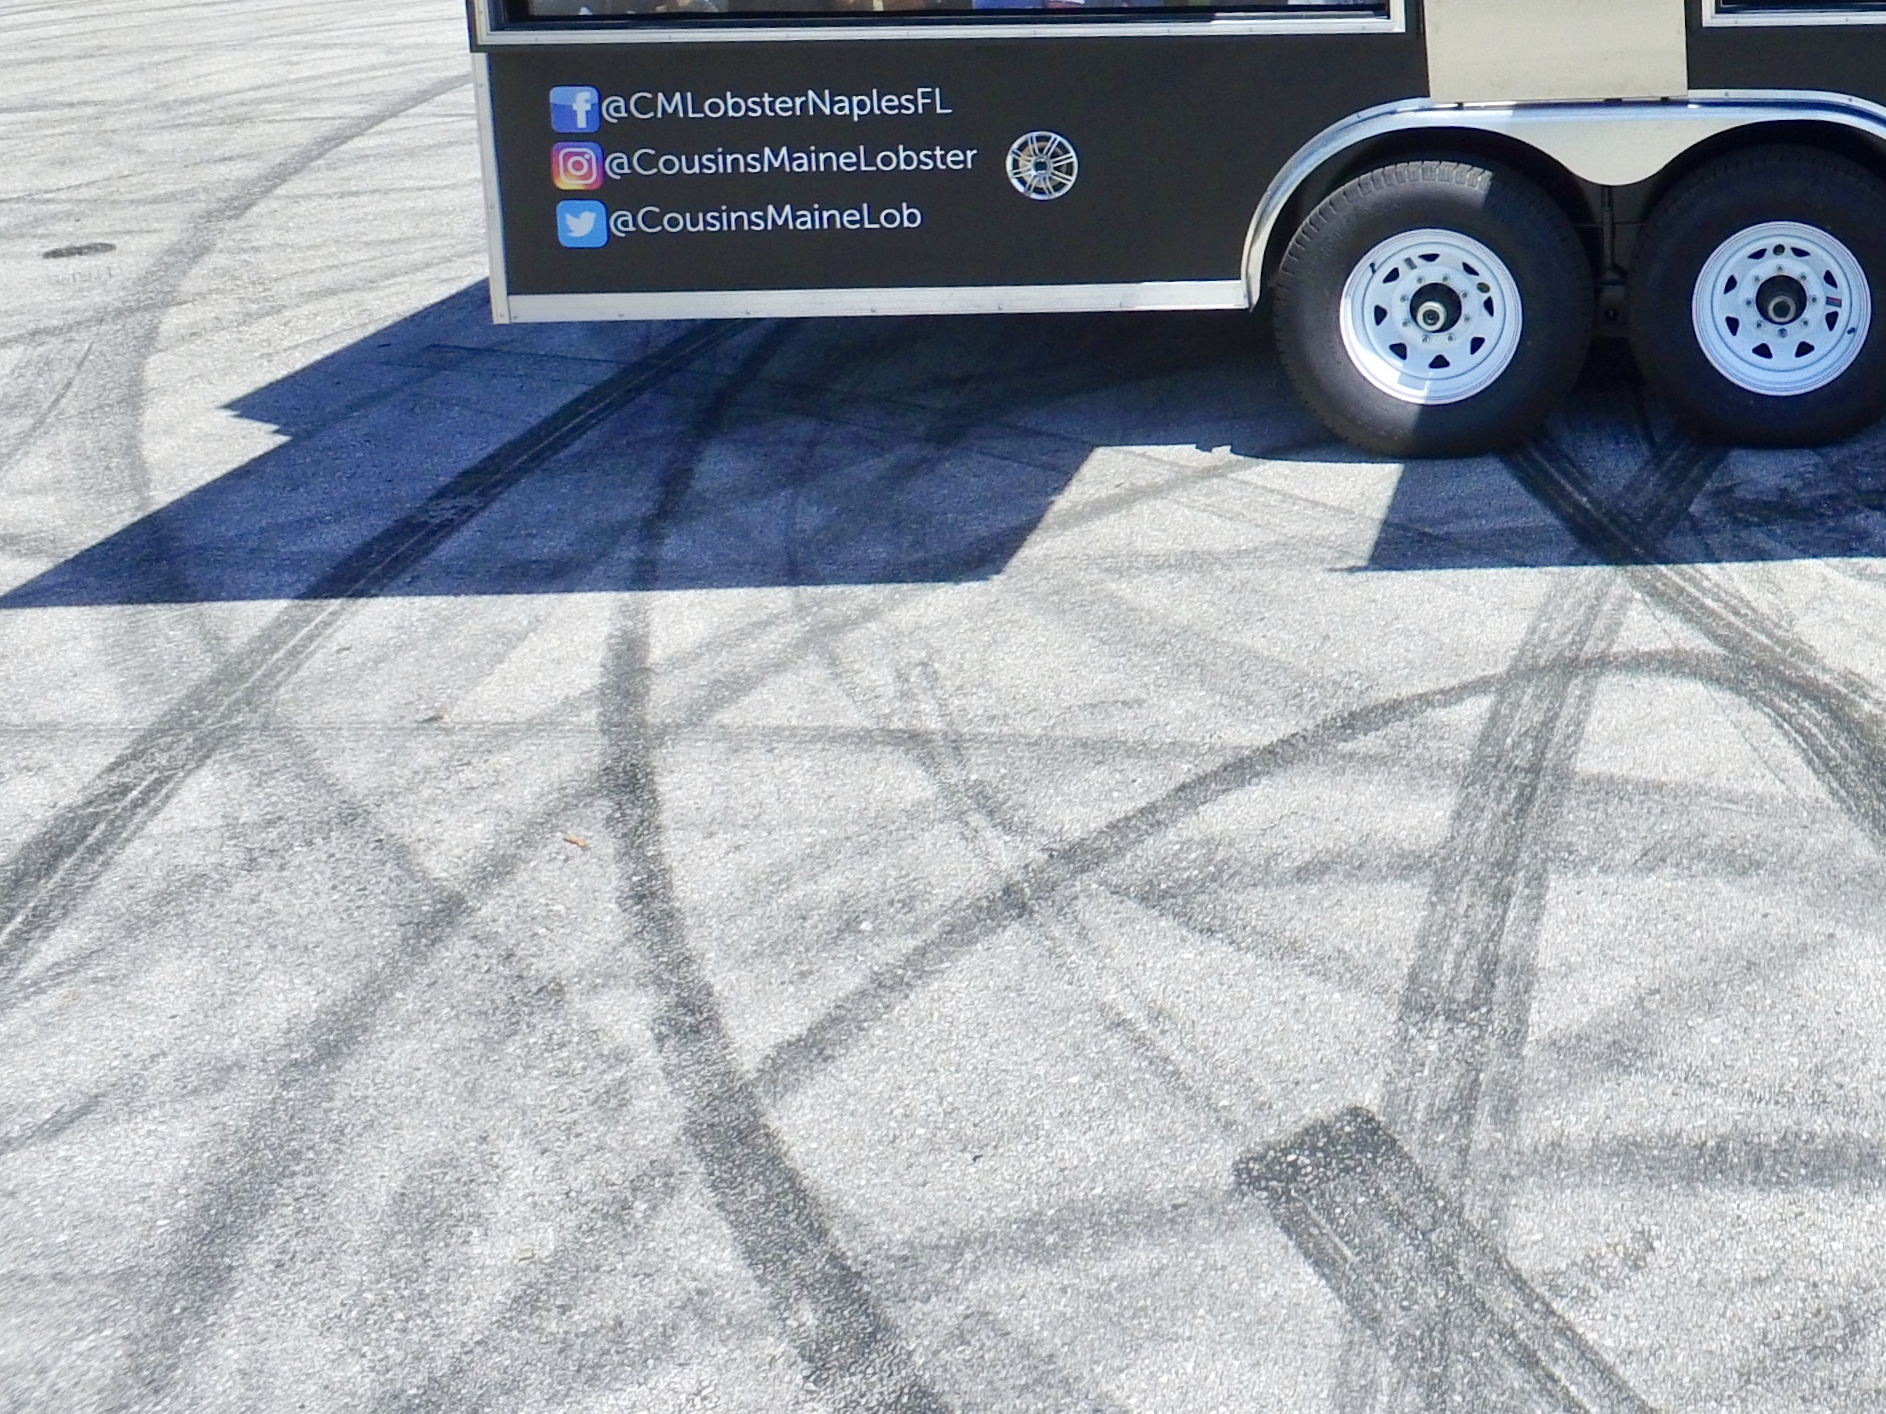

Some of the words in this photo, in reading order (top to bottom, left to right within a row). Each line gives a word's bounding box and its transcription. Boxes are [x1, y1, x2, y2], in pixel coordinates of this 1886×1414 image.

[600, 87, 953, 126] @CMLobsterNaplesFL
[604, 144, 978, 181] @CousinsMaineLobster
[609, 202, 923, 238] @CousinsMaineLob
